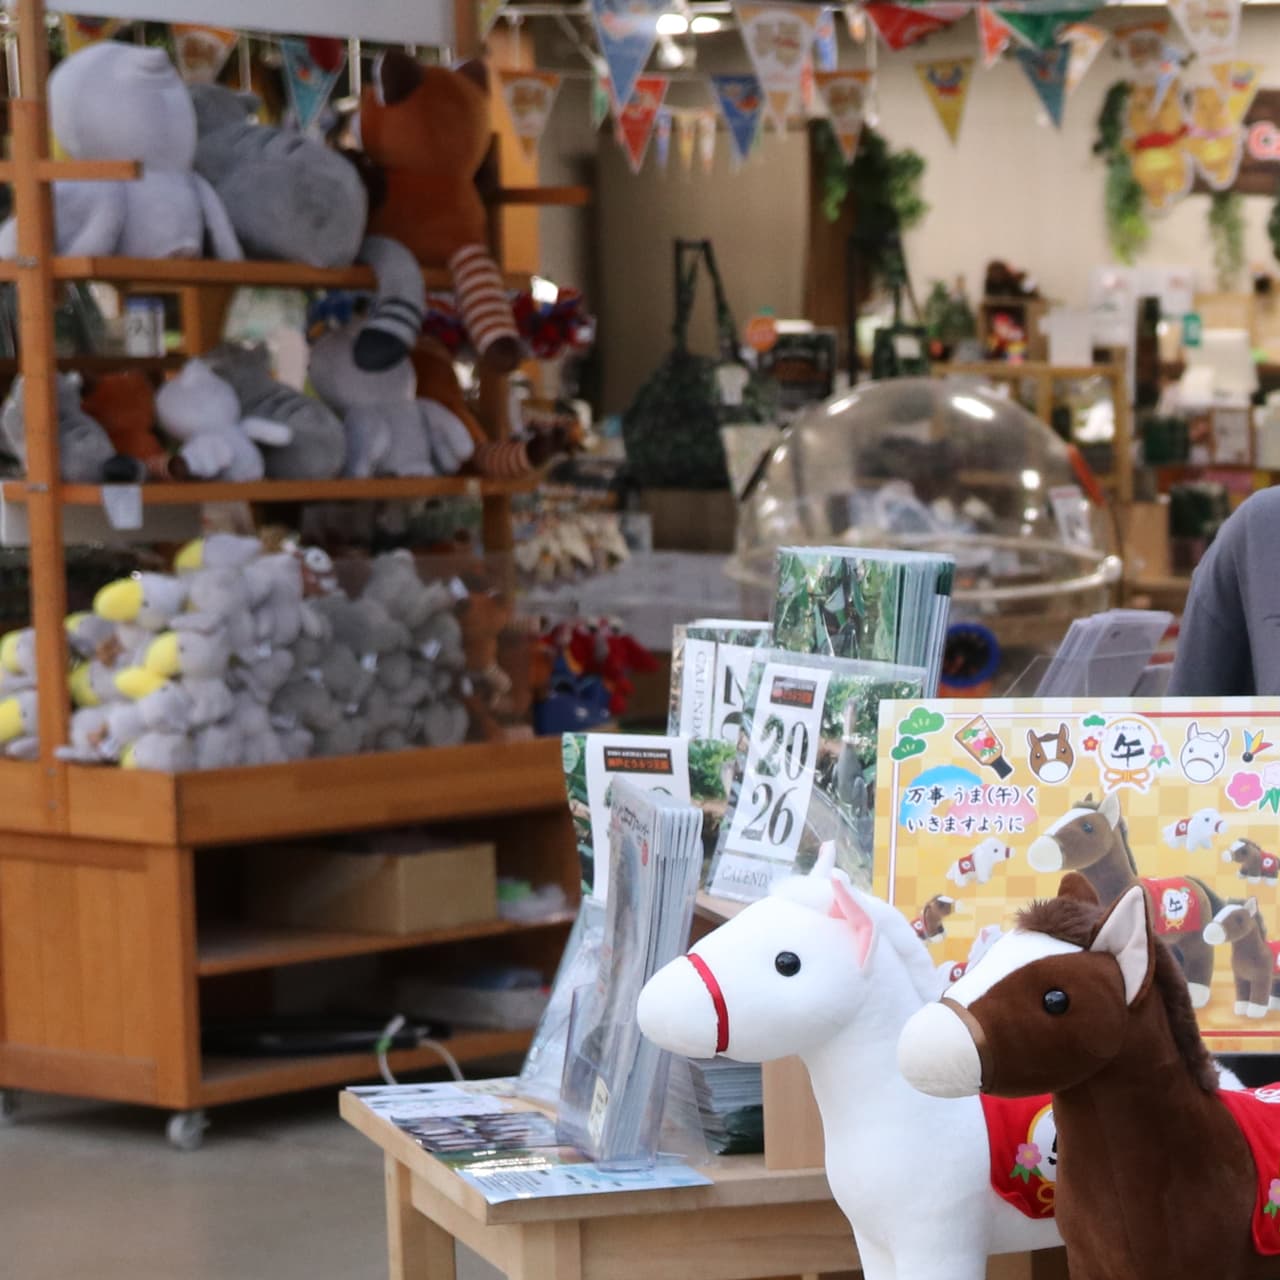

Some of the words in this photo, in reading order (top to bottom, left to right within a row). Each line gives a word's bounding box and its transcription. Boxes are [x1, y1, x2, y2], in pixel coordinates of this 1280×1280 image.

[757, 714, 809, 780] 20
[1111, 733, 1144, 768] 午
[741, 783, 798, 846] 26
[907, 813, 1024, 833] いきますように
